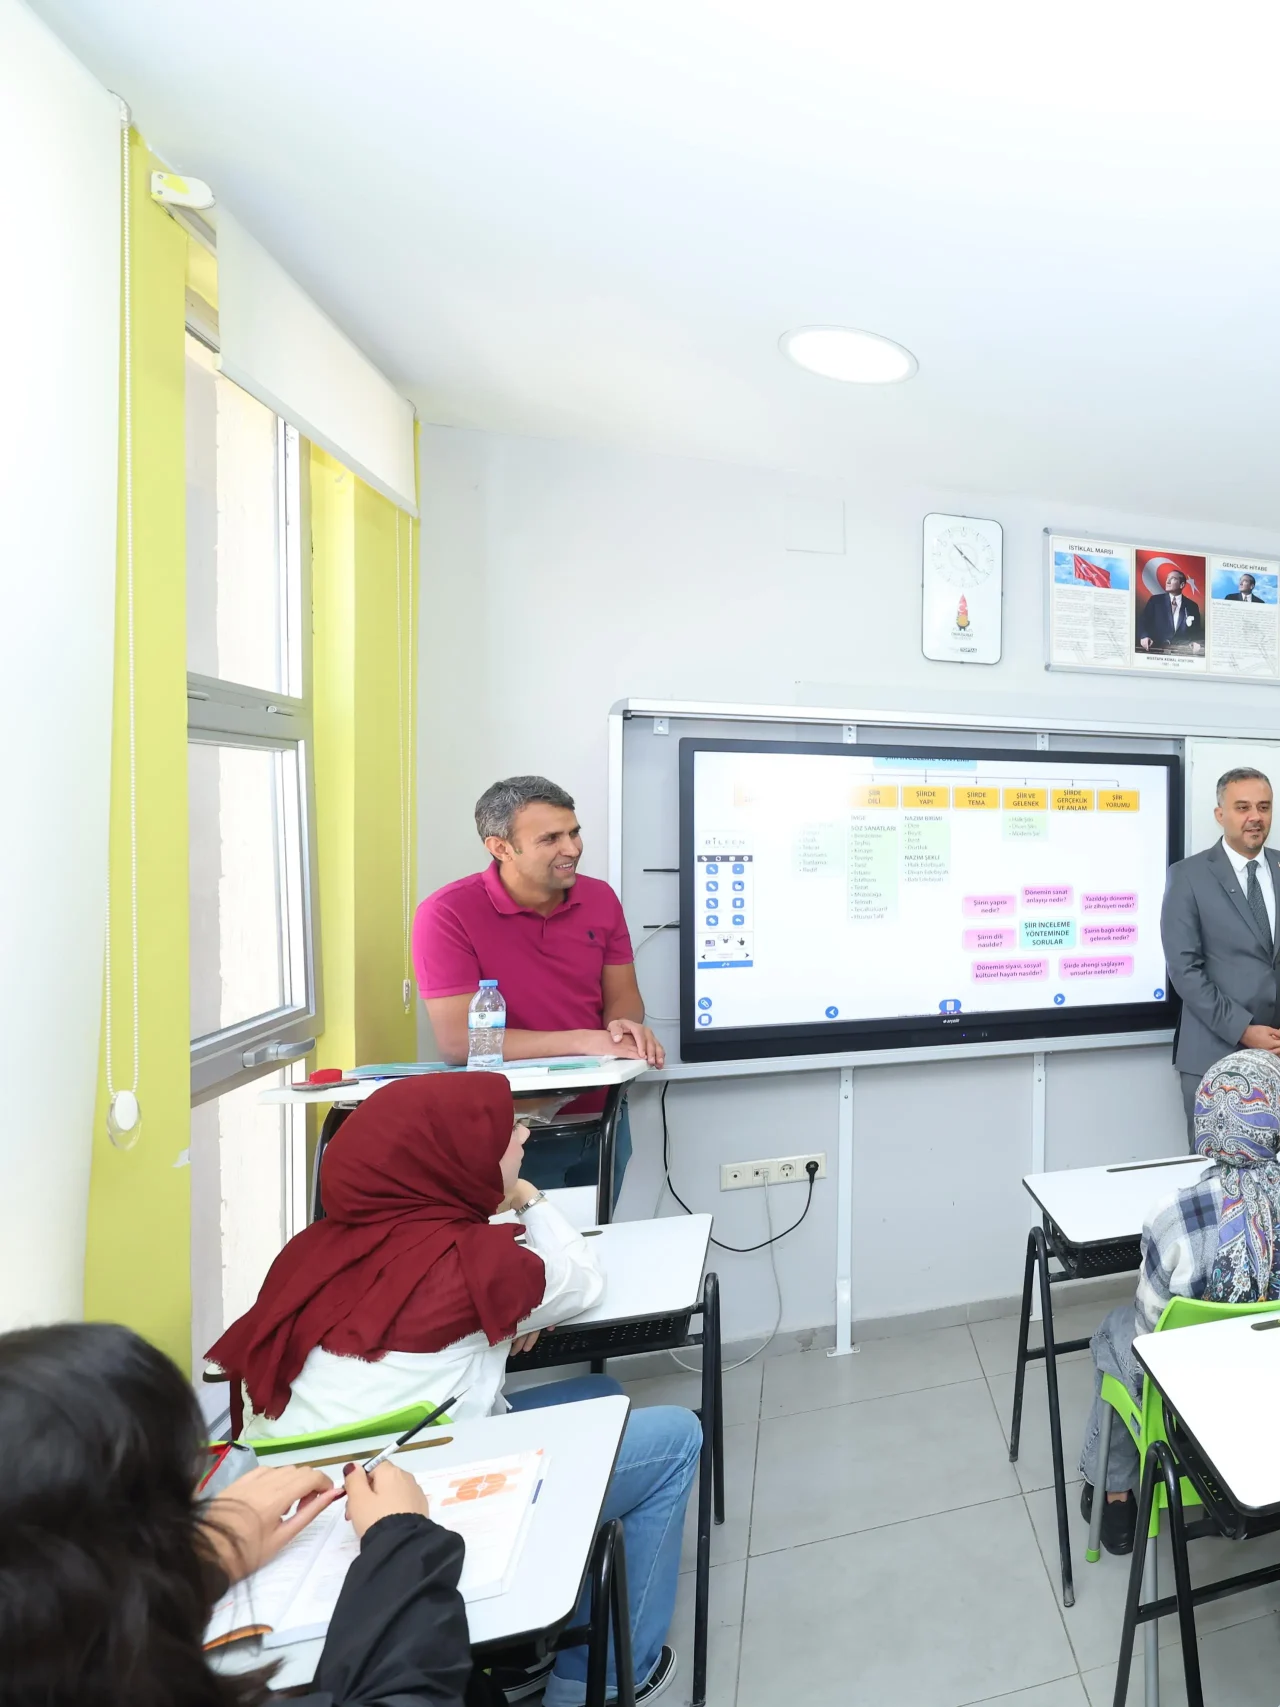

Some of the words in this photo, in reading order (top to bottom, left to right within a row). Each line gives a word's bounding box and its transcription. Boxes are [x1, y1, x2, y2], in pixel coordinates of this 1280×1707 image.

[1068, 544, 1094, 553] İSTİKLAL
[1095, 547, 1114, 555] MARŞI
[916, 790, 936, 798] ŞİİRDE
[1106, 801, 1130, 809] YORUMU
[1024, 922, 1037, 930] ŞİİR
[1032, 938, 1063, 946] SORULAR
